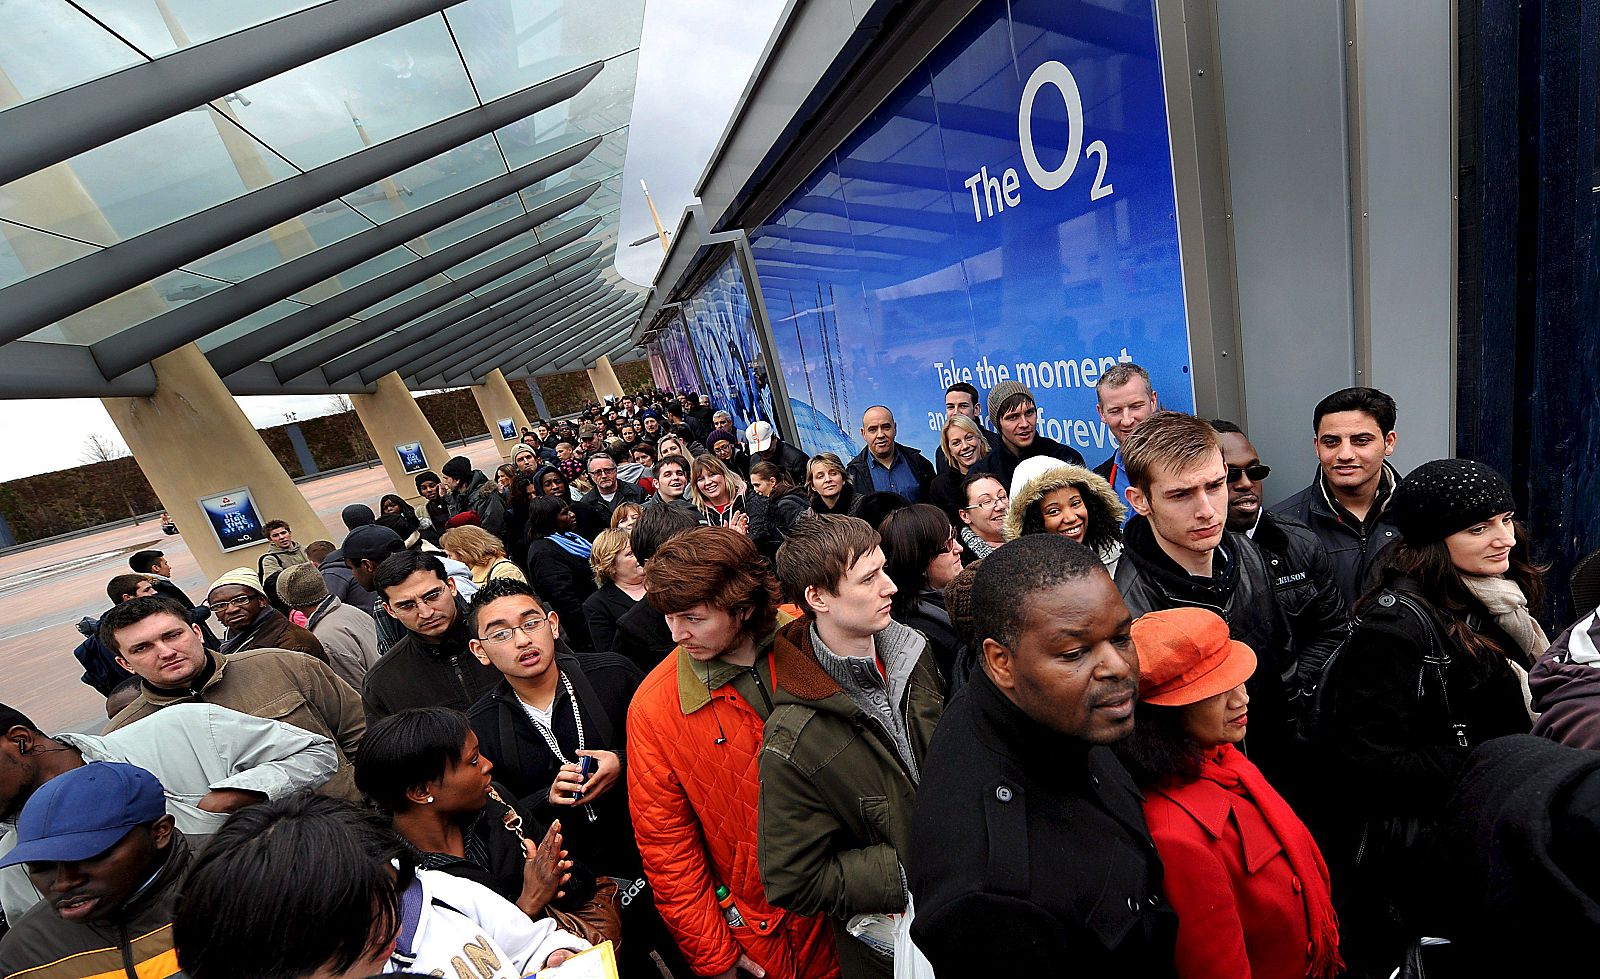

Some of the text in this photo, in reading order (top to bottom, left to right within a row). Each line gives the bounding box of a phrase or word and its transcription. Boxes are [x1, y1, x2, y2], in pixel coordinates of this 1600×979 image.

[964, 60, 1114, 223] The O2
[933, 359, 973, 390] Take
[975, 356, 1010, 389] the
[927, 411, 947, 432] an
[1037, 407, 1119, 449] forev
[620, 878, 646, 909] das
[430, 934, 502, 979] AN
